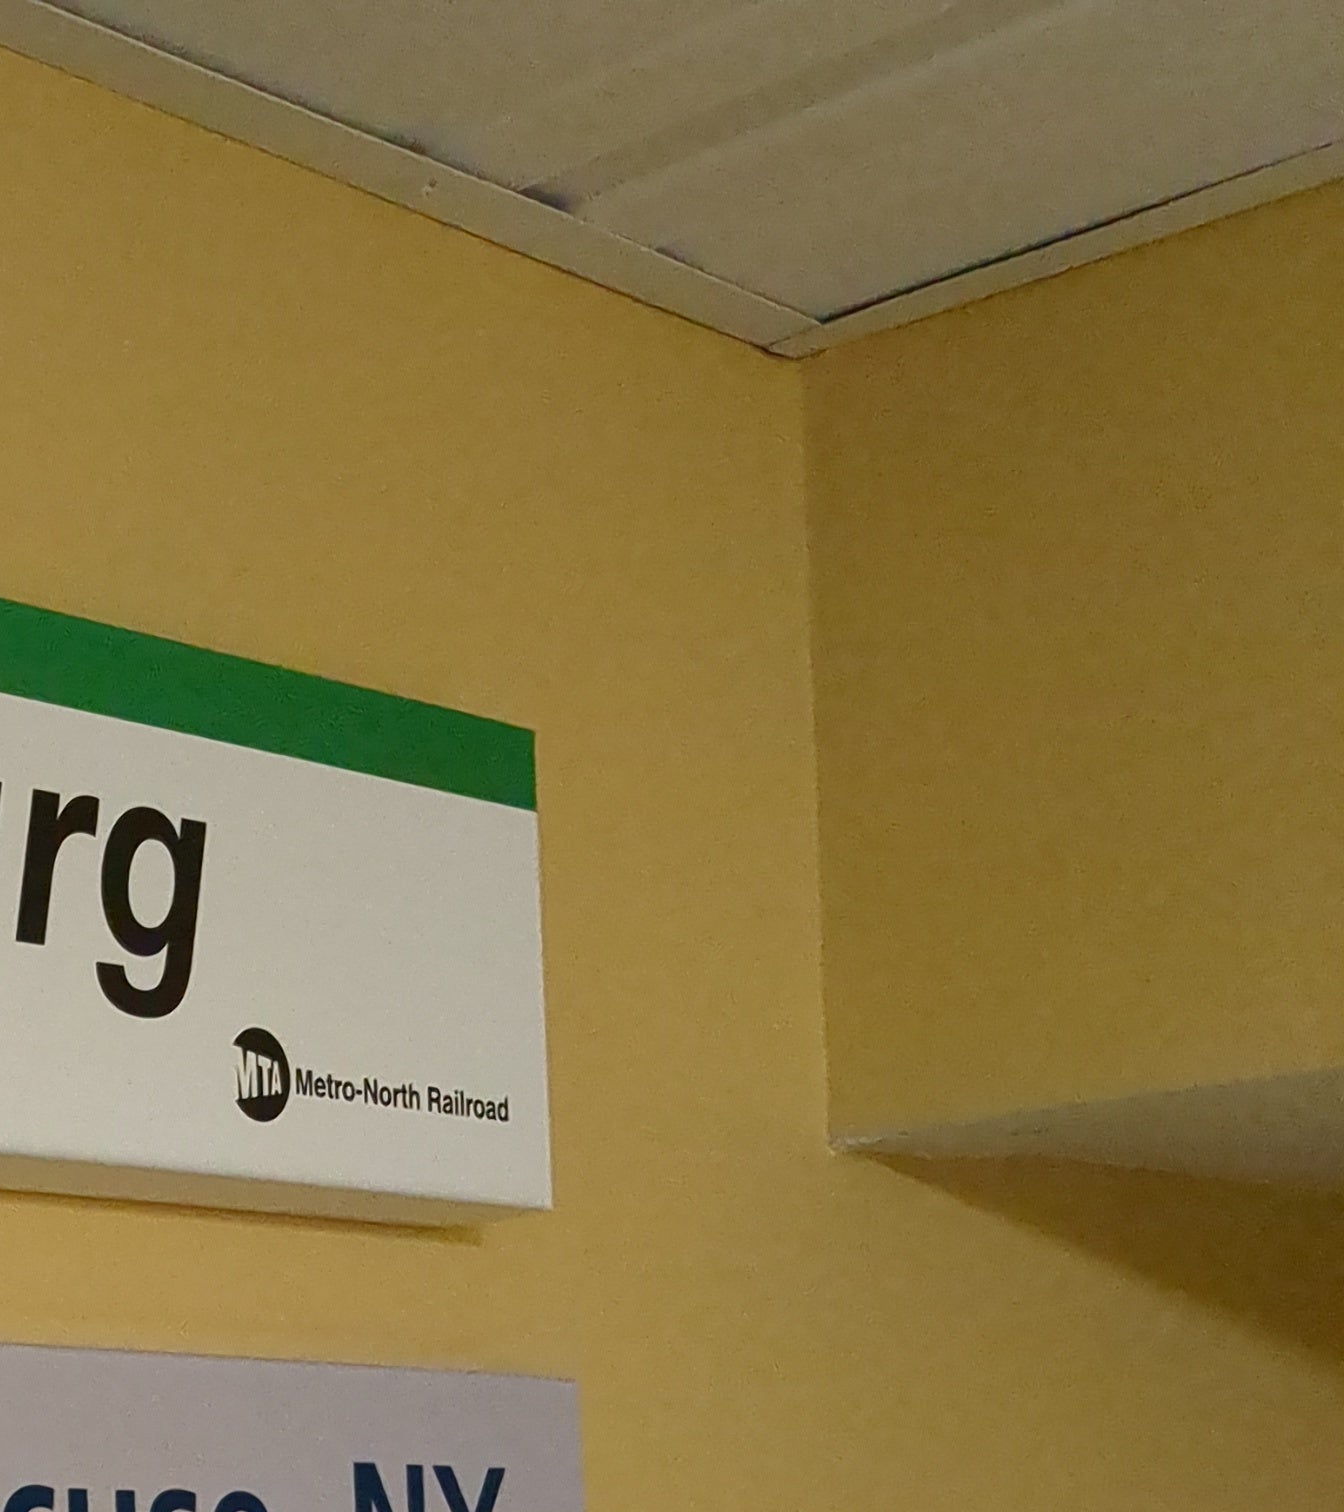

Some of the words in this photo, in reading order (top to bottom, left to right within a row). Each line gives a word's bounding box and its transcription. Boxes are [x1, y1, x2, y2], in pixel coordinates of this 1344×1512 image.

[234, 1046, 286, 1101] MTA
[294, 1066, 422, 1111] Metro-North
[426, 1085, 510, 1123] Railroad
